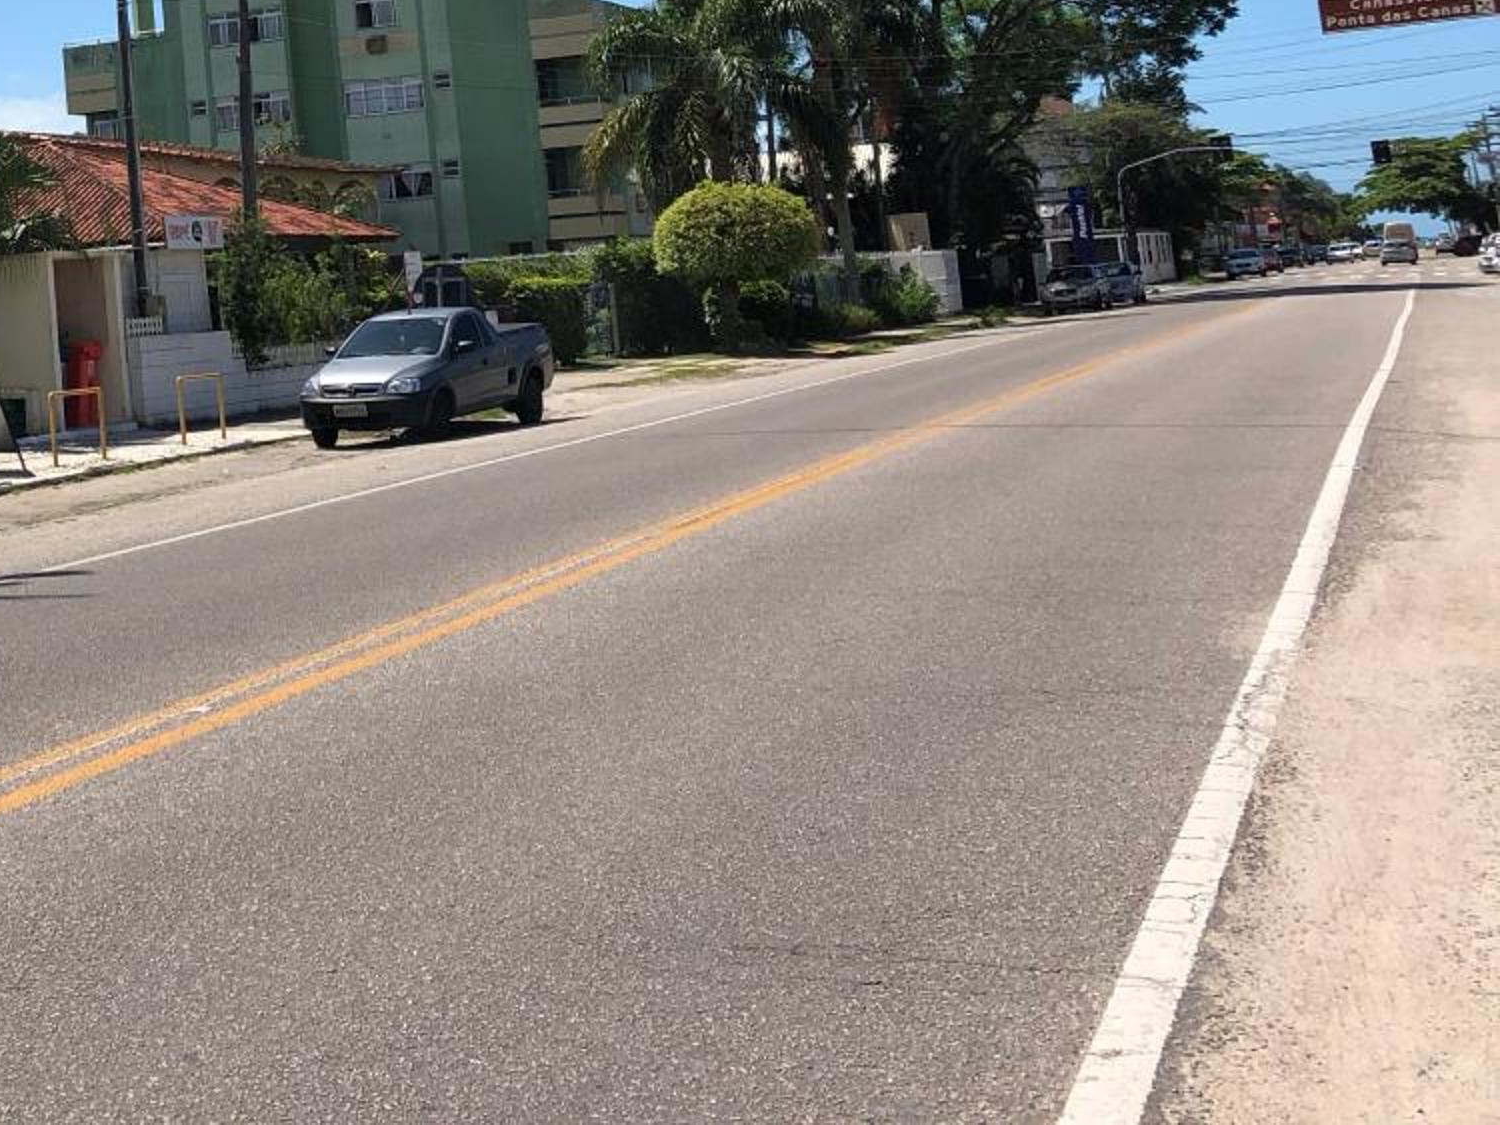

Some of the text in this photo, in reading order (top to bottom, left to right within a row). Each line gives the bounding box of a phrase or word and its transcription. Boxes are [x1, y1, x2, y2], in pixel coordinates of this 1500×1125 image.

[1327, 5, 1471, 27] Ponta das Canas
